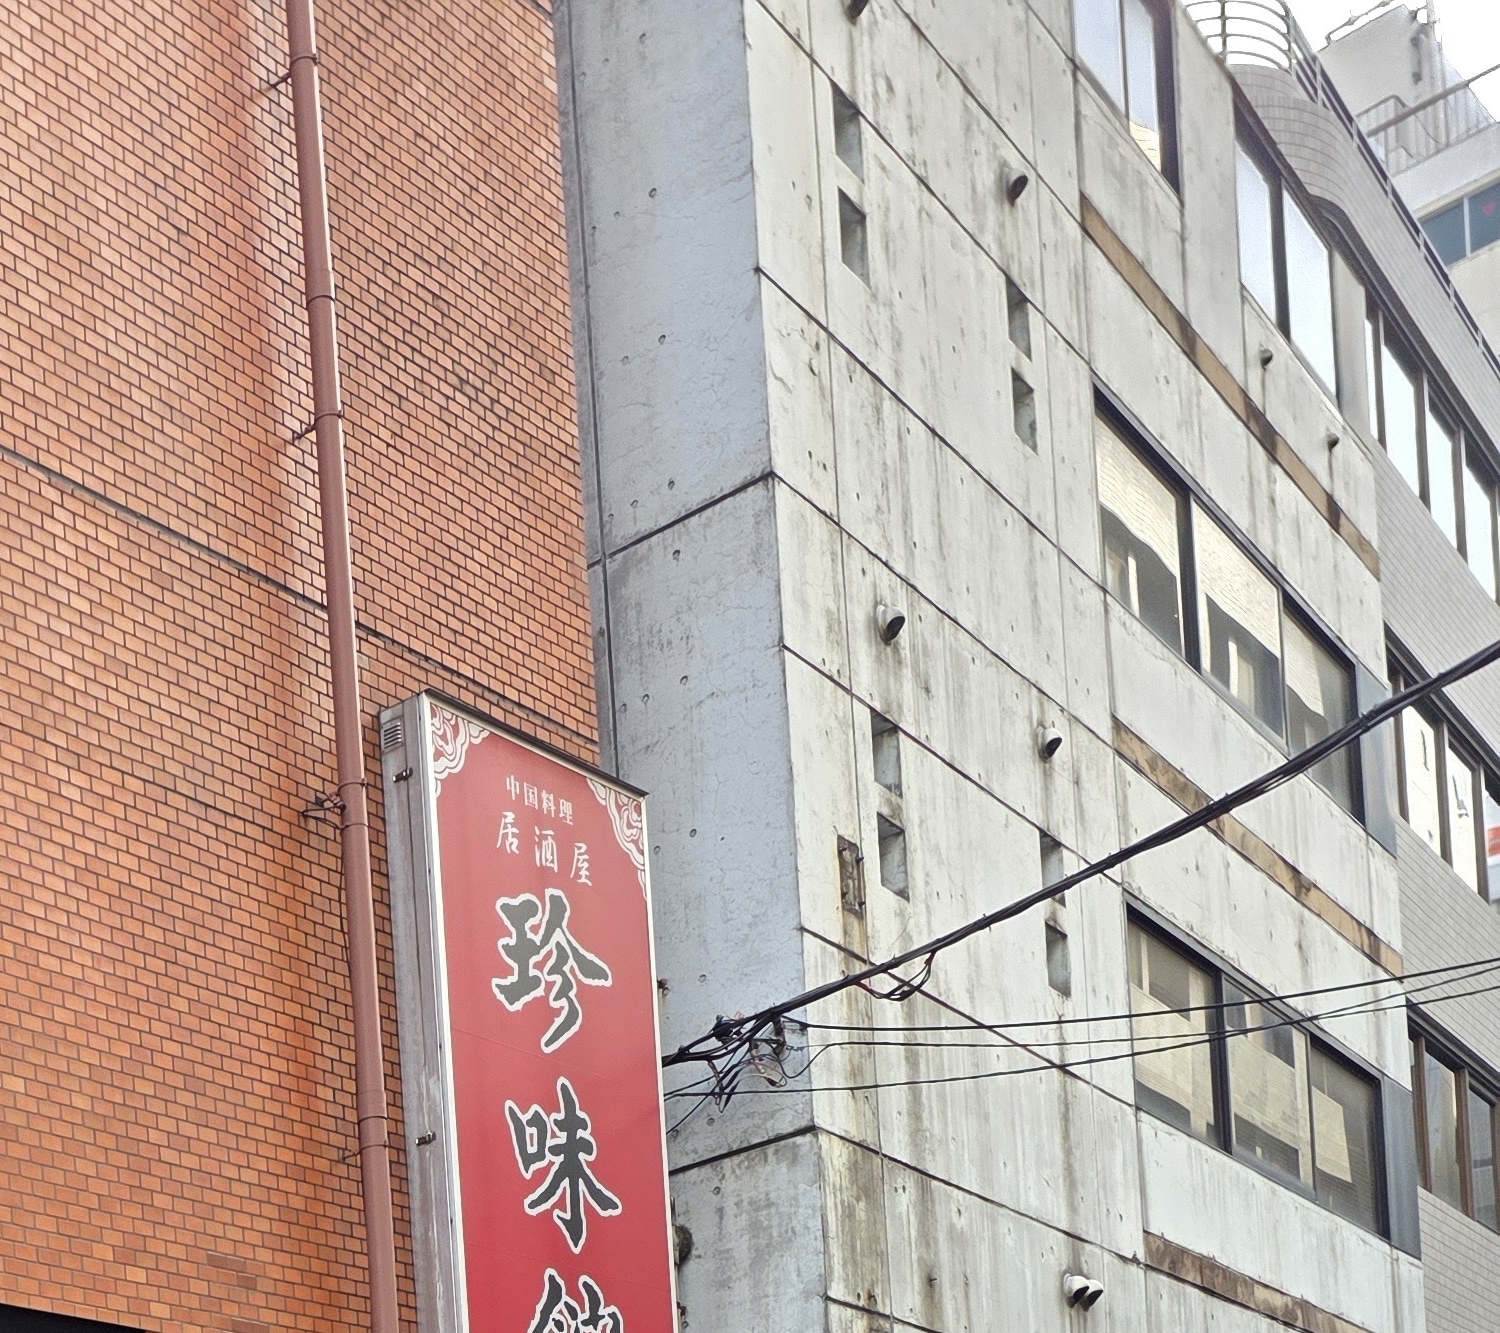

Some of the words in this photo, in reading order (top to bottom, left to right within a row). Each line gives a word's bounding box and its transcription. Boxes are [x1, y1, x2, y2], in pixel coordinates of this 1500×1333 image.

[505, 774, 574, 826] 中国料理
[495, 811, 593, 887] 居酒屋
